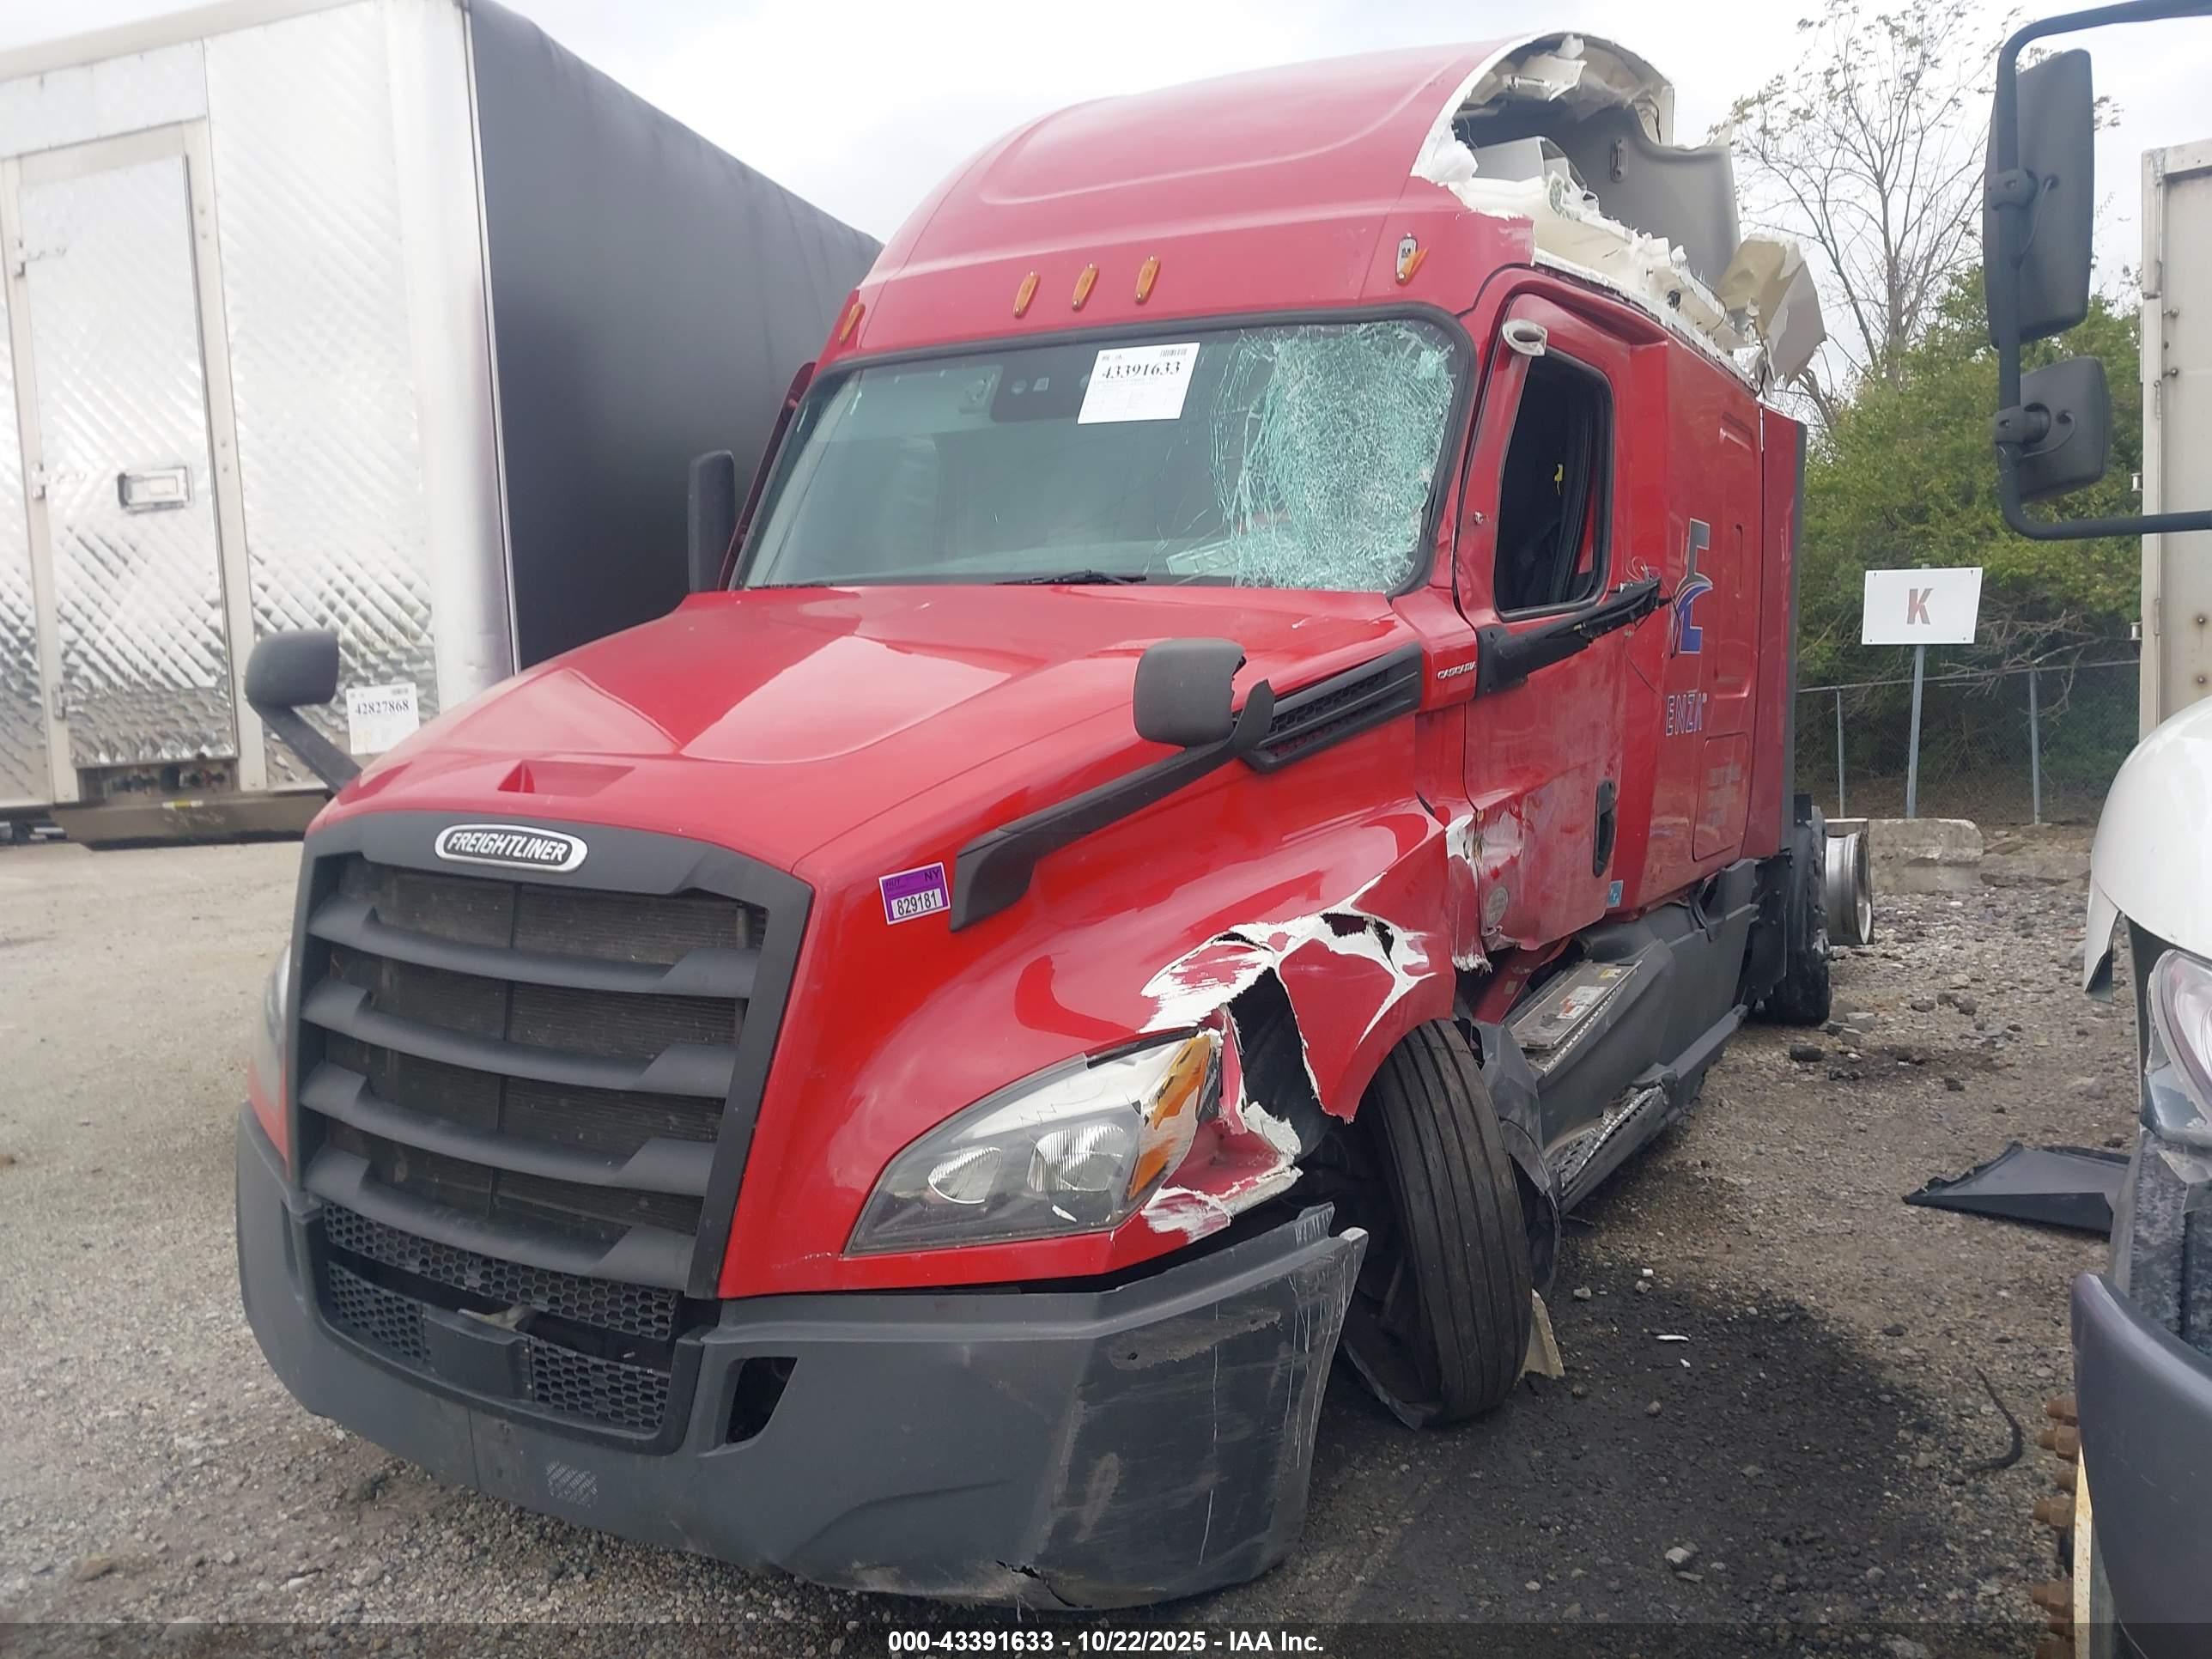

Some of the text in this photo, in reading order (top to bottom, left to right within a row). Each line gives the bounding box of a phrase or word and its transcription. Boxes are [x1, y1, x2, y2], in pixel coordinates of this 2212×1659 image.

[1102, 361, 1181, 379] 43391633
[1906, 588, 1934, 625] K
[356, 700, 410, 715] 42827868
[447, 831, 568, 862] FREIGHTLINER
[924, 869, 939, 882] NY
[896, 890, 938, 916] 829181
